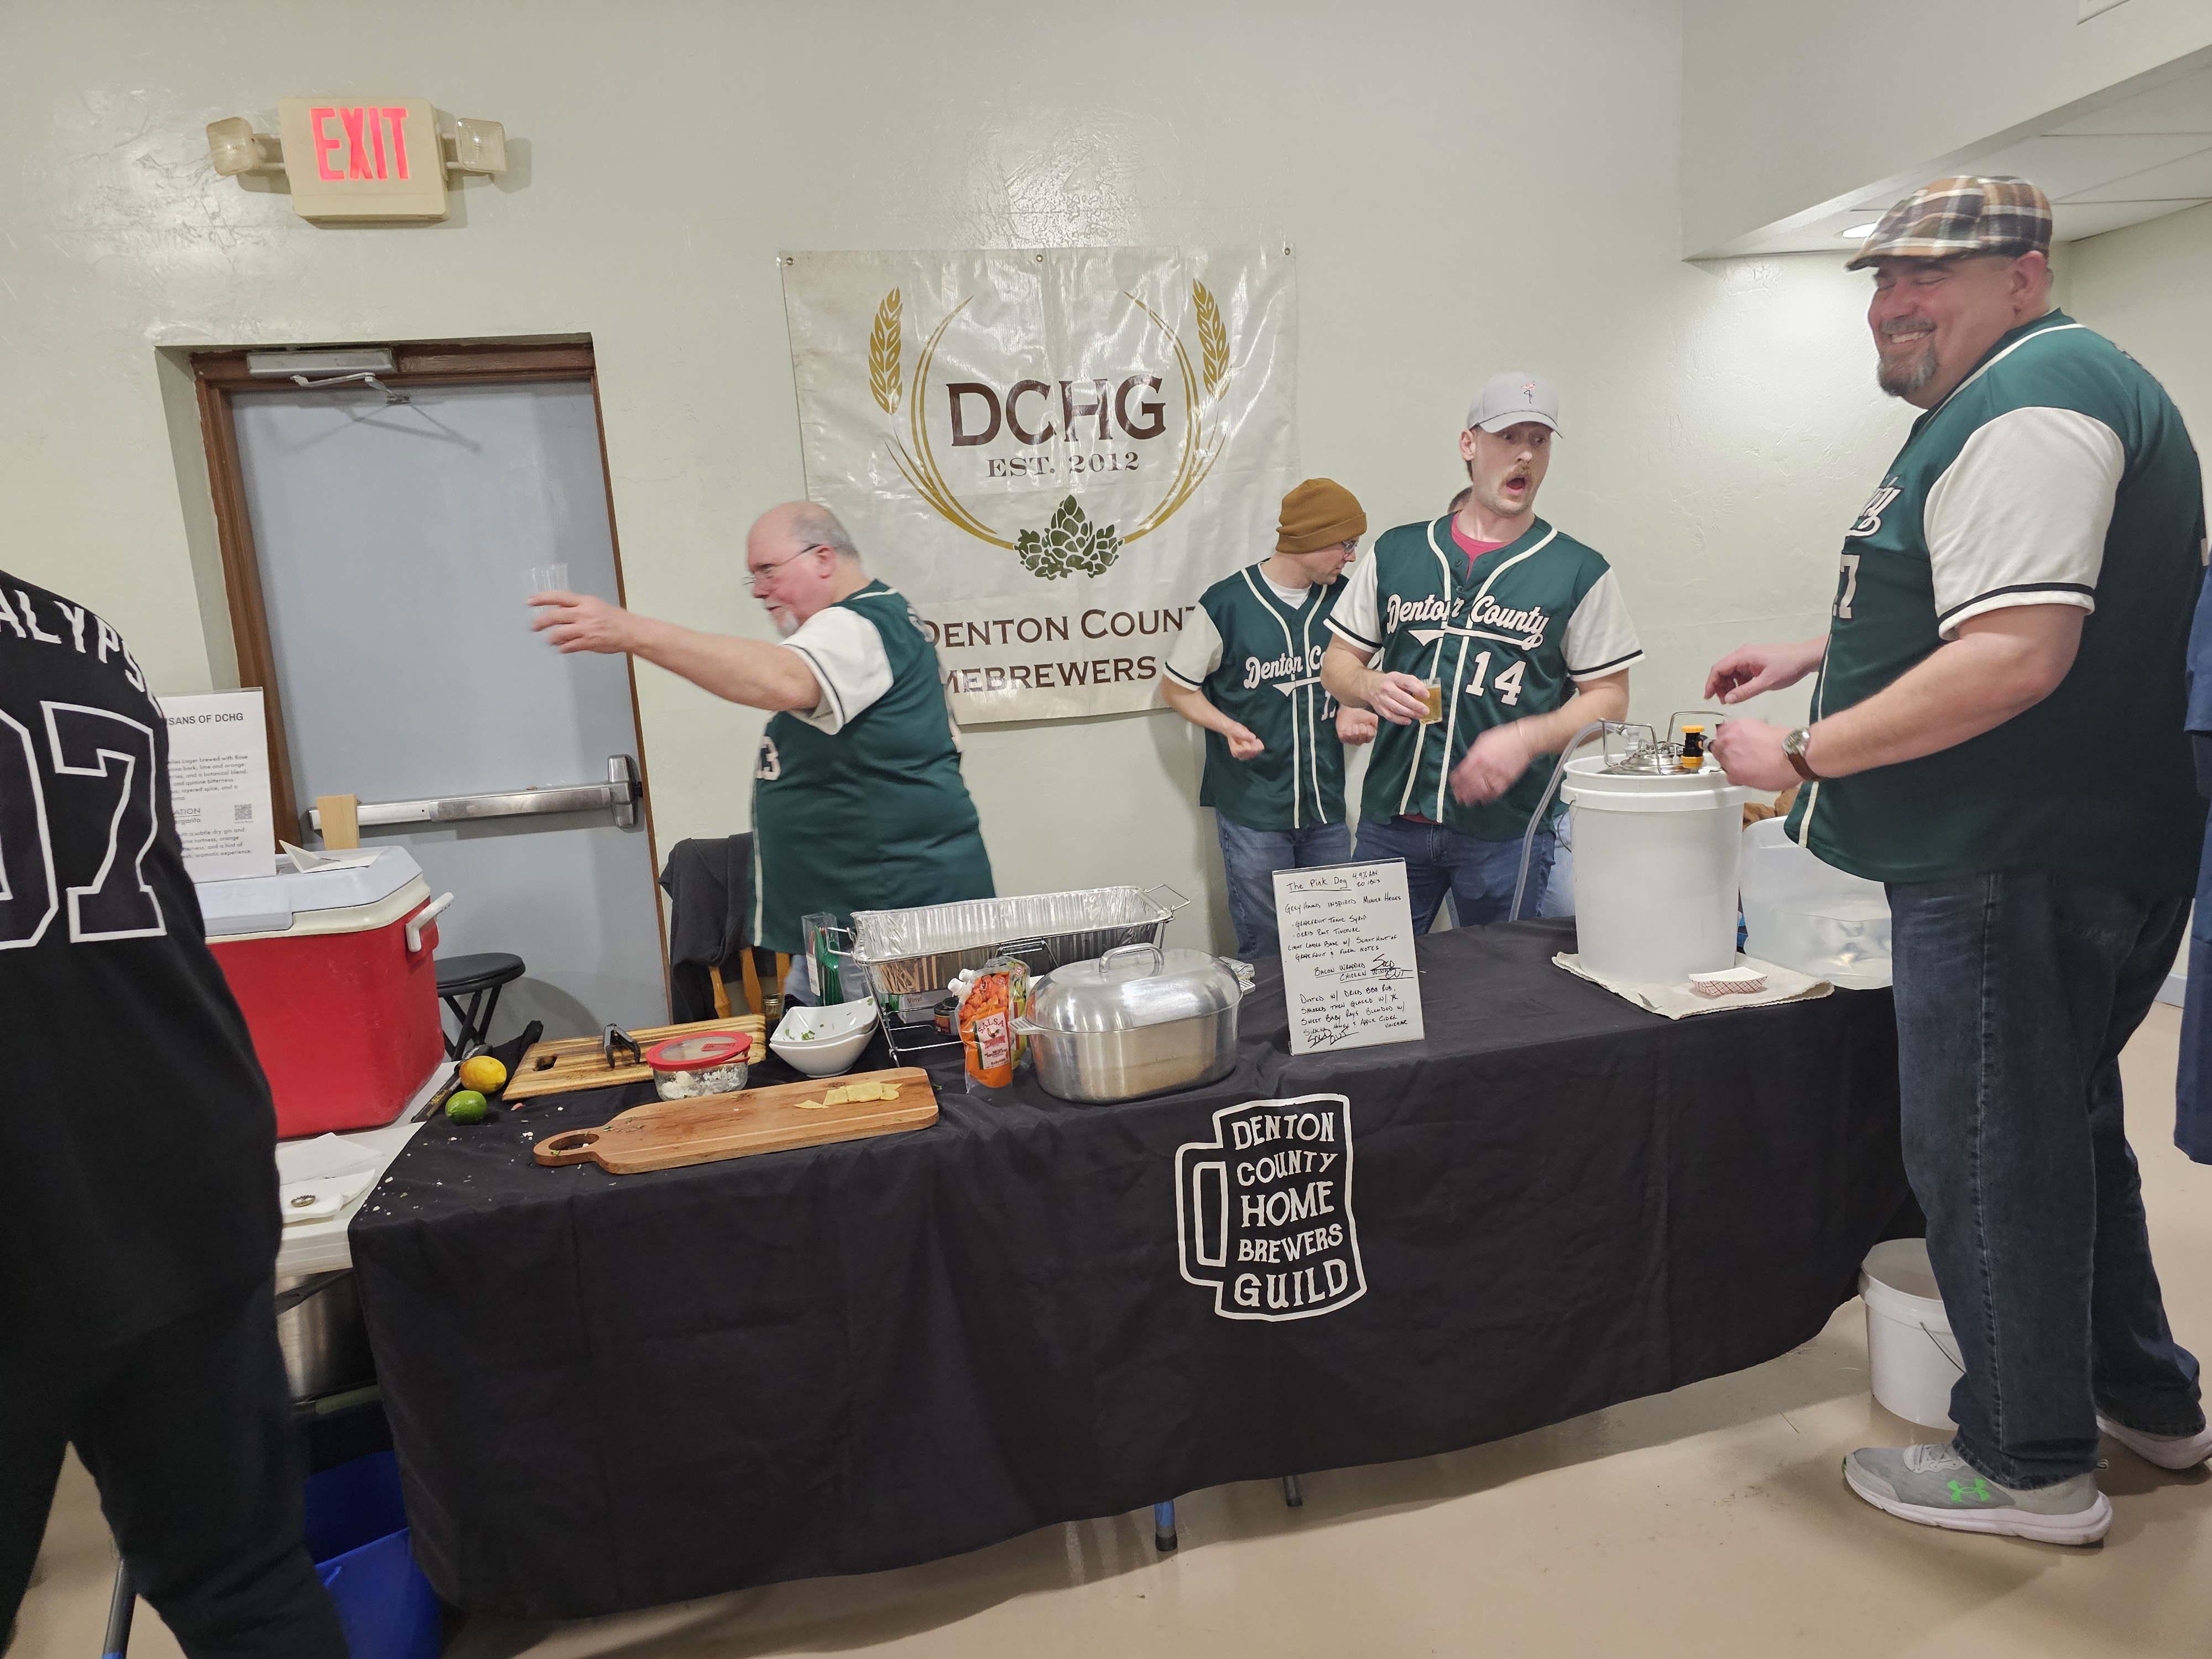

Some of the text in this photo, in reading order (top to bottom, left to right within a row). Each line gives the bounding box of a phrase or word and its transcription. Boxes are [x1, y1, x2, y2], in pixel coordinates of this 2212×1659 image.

[310, 107, 409, 181] EXIT
[946, 374, 1166, 446] DCHG
[985, 452, 1140, 477] EST. 2012
[1081, 606, 1196, 638] COUN
[1386, 594, 1549, 646] Denton County
[1244, 653, 1303, 689] Denton
[1465, 651, 1526, 706] 14
[199, 714, 211, 723] OF
[215, 712, 243, 722] DCHG
[1286, 881, 1304, 890] The
[1310, 877, 1328, 888] Pink
[1334, 877, 1348, 889] Dog
[1352, 870, 1368, 880] 4.9%
[978, 1018, 1004, 1034] SALSA
[1231, 1112, 1334, 1150] DENTON
[1237, 1150, 1338, 1186] COUNTY
[1241, 1181, 1334, 1228] HOME
[1238, 1223, 1344, 1263] BREWERS
[1234, 1258, 1348, 1309] GUILD
